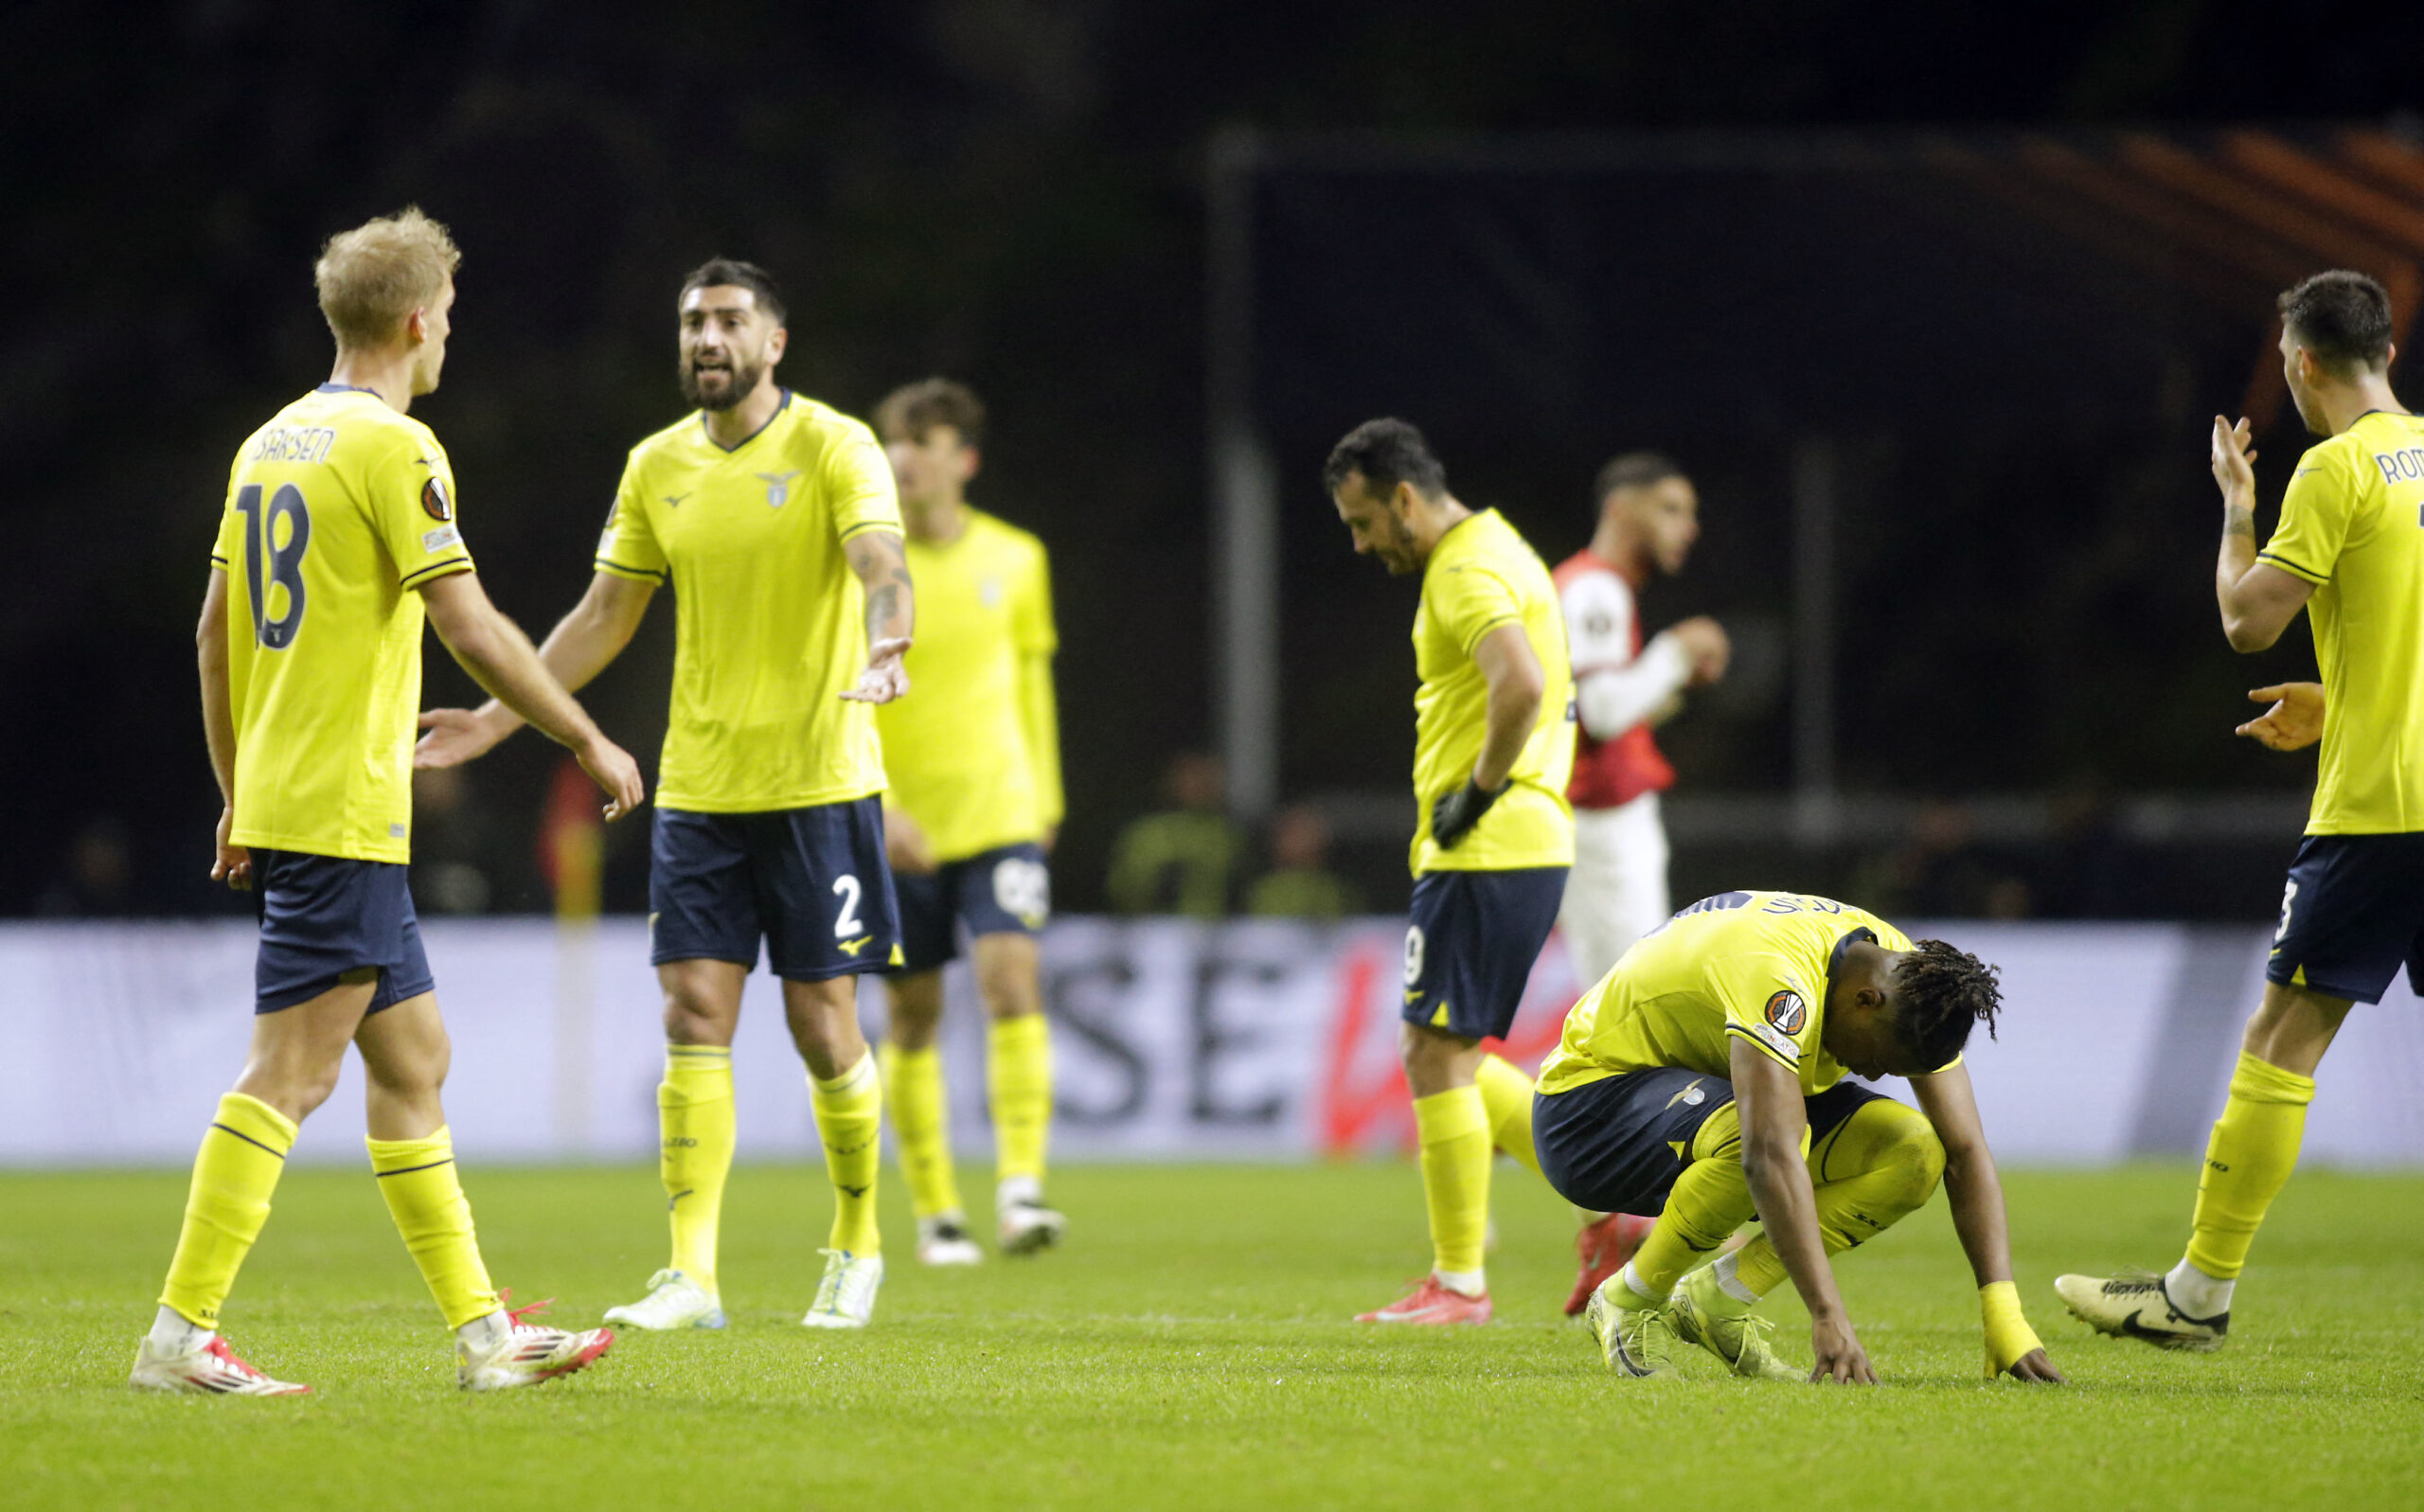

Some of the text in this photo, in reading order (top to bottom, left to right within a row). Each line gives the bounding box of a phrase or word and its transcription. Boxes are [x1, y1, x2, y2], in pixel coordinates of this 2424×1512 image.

[236, 483, 311, 650] 18
[831, 874, 864, 938] 2
[2273, 878, 2299, 942] 3
[1403, 924, 1425, 986] 9
